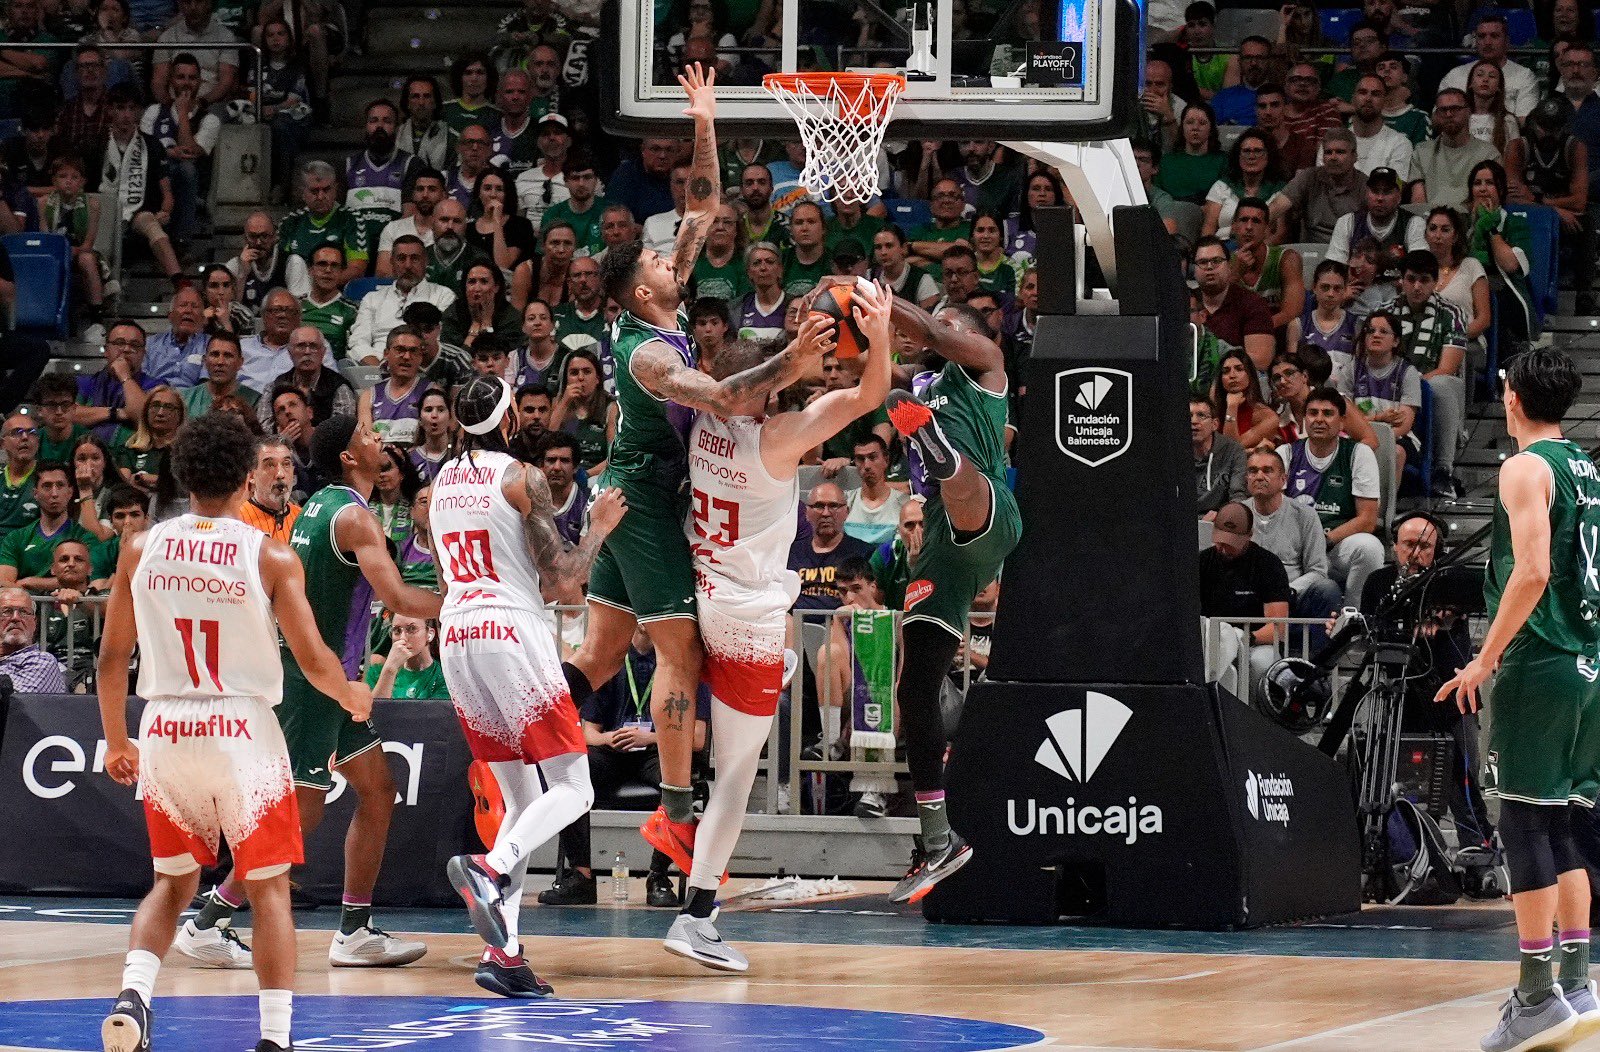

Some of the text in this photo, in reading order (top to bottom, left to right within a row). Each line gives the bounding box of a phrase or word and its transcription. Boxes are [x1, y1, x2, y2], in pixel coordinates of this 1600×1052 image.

[1033, 60, 1070, 68] PLAYOFF
[1067, 413, 1120, 425] Fundación
[1075, 425, 1113, 439] Unicaja
[698, 429, 737, 460] GEBEN
[1067, 436, 1121, 446] Baloncesto
[438, 466, 497, 488] ROBINSON
[688, 452, 747, 484] nmoovs
[690, 487, 740, 548] 23
[165, 538, 238, 566] TAYLOR
[442, 529, 501, 583] 00
[148, 570, 246, 597] inmoovs
[799, 567, 818, 584] EW
[445, 620, 521, 648] Aquaflix
[174, 617, 224, 693] 11
[147, 714, 253, 744] Aquaflix
[1257, 772, 1295, 797] Fundación
[1007, 795, 1163, 845] Unicaja
[1261, 797, 1291, 828] Unicaja
[247, 998, 653, 1052] IGUERÓN
